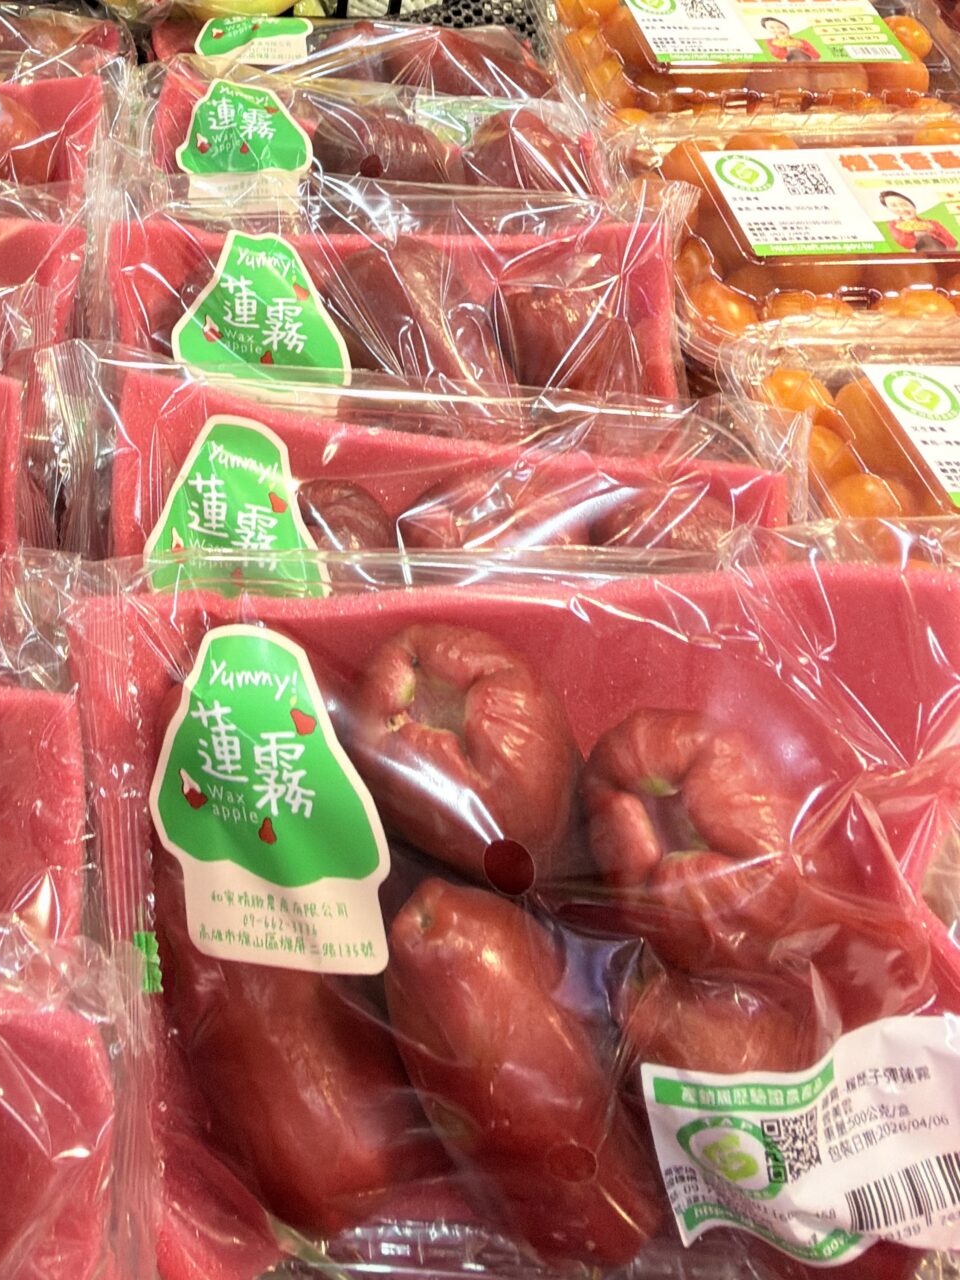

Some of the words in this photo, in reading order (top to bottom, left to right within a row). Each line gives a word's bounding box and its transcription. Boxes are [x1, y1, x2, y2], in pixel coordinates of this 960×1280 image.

[207, 96, 276, 141] 蓮霧
[237, 246, 296, 278] Yummy!
[221, 275, 308, 353] 蓮霧
[209, 660, 299, 702] Yummy!
[191, 700, 316, 818] 蓮霧
[206, 783, 245, 805] Wax
[211, 803, 259, 825] apple
